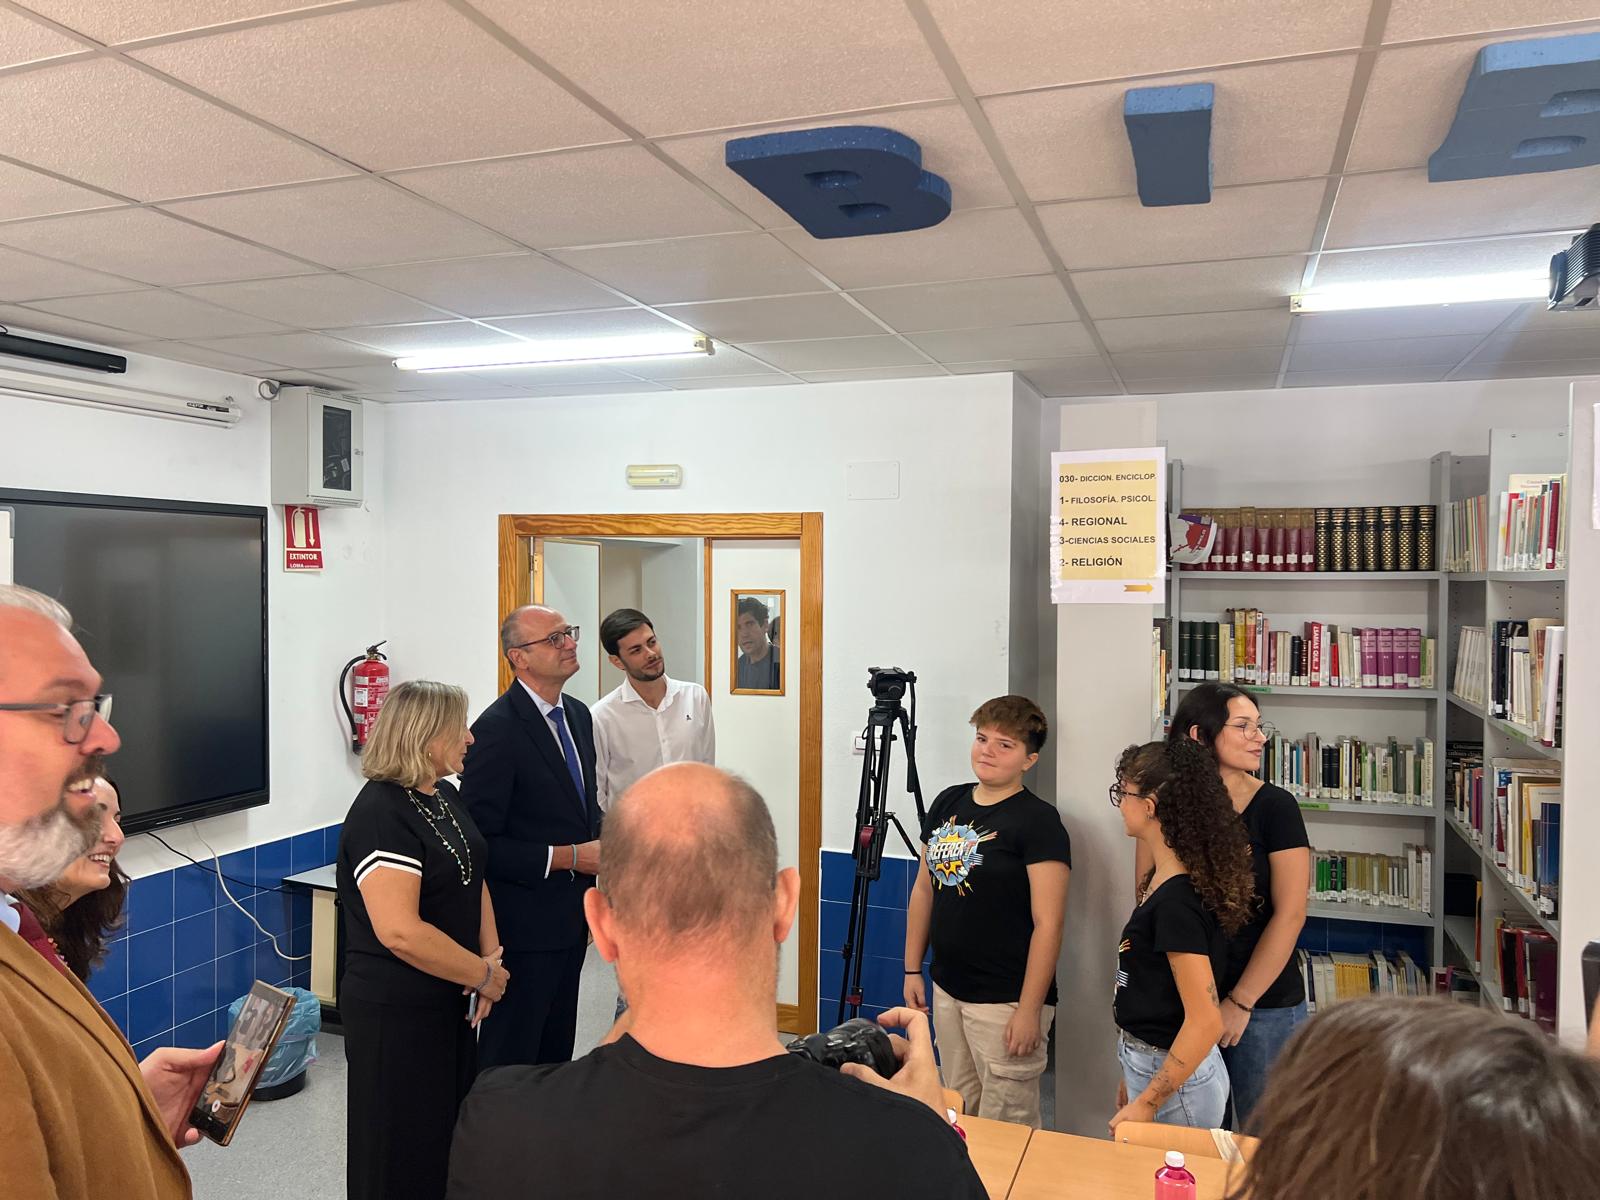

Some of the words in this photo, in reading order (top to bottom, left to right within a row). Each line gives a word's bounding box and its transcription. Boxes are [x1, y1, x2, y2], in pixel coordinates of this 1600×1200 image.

[1059, 475, 1078, 483] 030-
[1115, 473, 1156, 481] ENCICLOP.
[1060, 496, 1069, 504] 1-
[1071, 494, 1118, 504] FILOSOFÍA.
[1059, 518, 1069, 526] 4-
[1071, 516, 1127, 526] REGIONAL
[1059, 536, 1109, 544] 3-CIENCIAS
[1111, 536, 1156, 544] SOCIALES
[1059, 558, 1069, 566] 2-
[1071, 556, 1123, 566] RELIGIÓN
